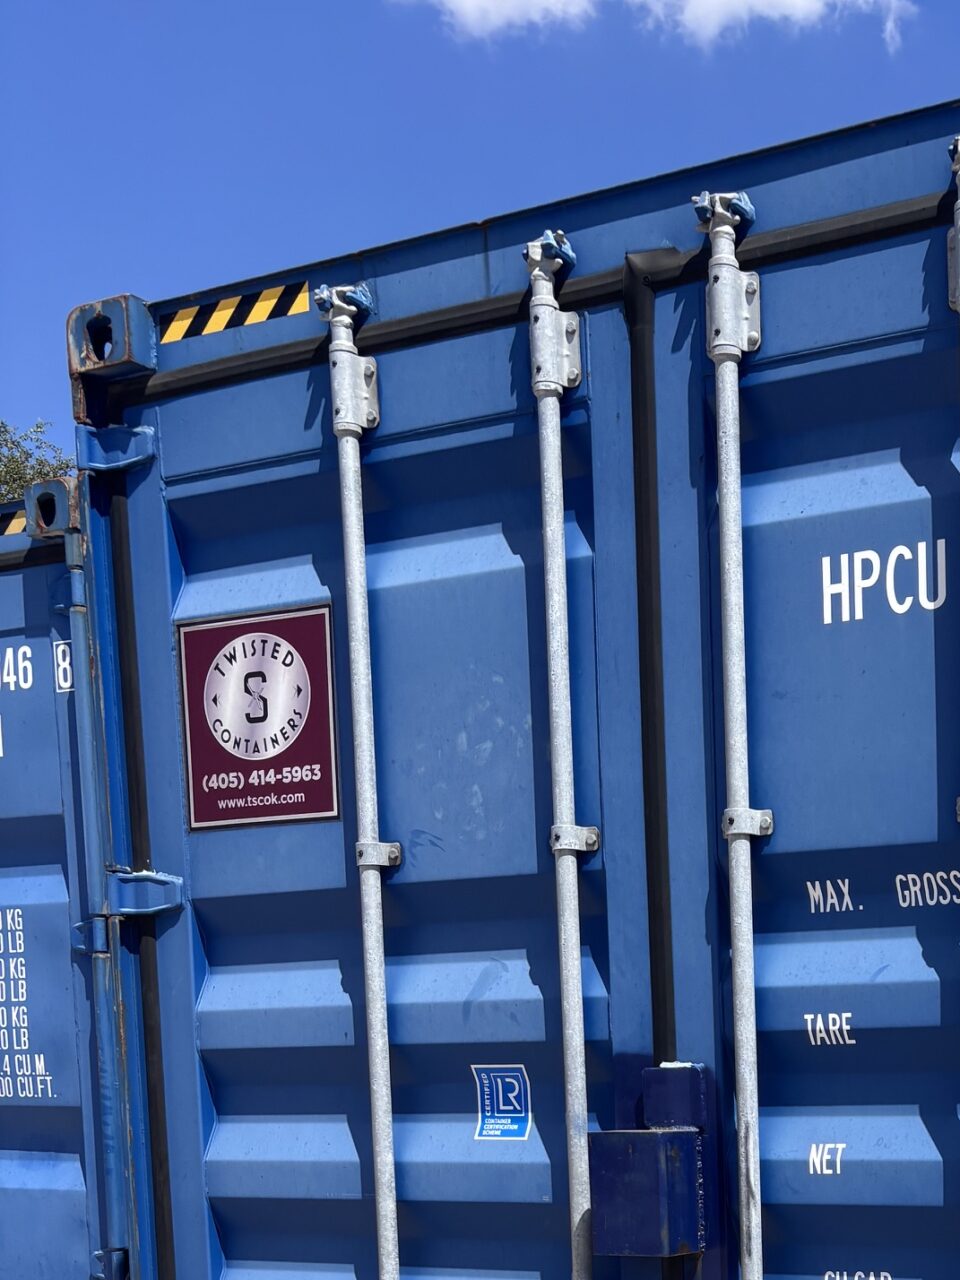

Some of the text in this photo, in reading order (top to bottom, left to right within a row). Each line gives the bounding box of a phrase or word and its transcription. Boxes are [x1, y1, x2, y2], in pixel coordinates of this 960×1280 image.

[822, 539, 946, 624] HPCU
[0, 644, 73, 691] 46 8
[213, 639, 295, 678] TWISTED
[212, 708, 302, 754] CONTAINERS
[202, 764, 322, 792] (405) 414-5963
[218, 792, 305, 809] www.tscok.com
[807, 879, 864, 914] MAX.
[7, 908, 23, 930] KG
[8, 931, 24, 953] LB
[9, 957, 26, 979] KG
[11, 980, 27, 1002] LB
[11, 1006, 28, 1028] KG
[804, 1012, 856, 1045] TARE
[13, 1028, 29, 1050] LB
[14, 1053, 49, 1075] CU.M.
[17, 1076, 57, 1098] CU.FT.
[481, 1073, 491, 1116] CERTIFIED
[497, 1078, 521, 1110] LR
[809, 1143, 846, 1175] NET
